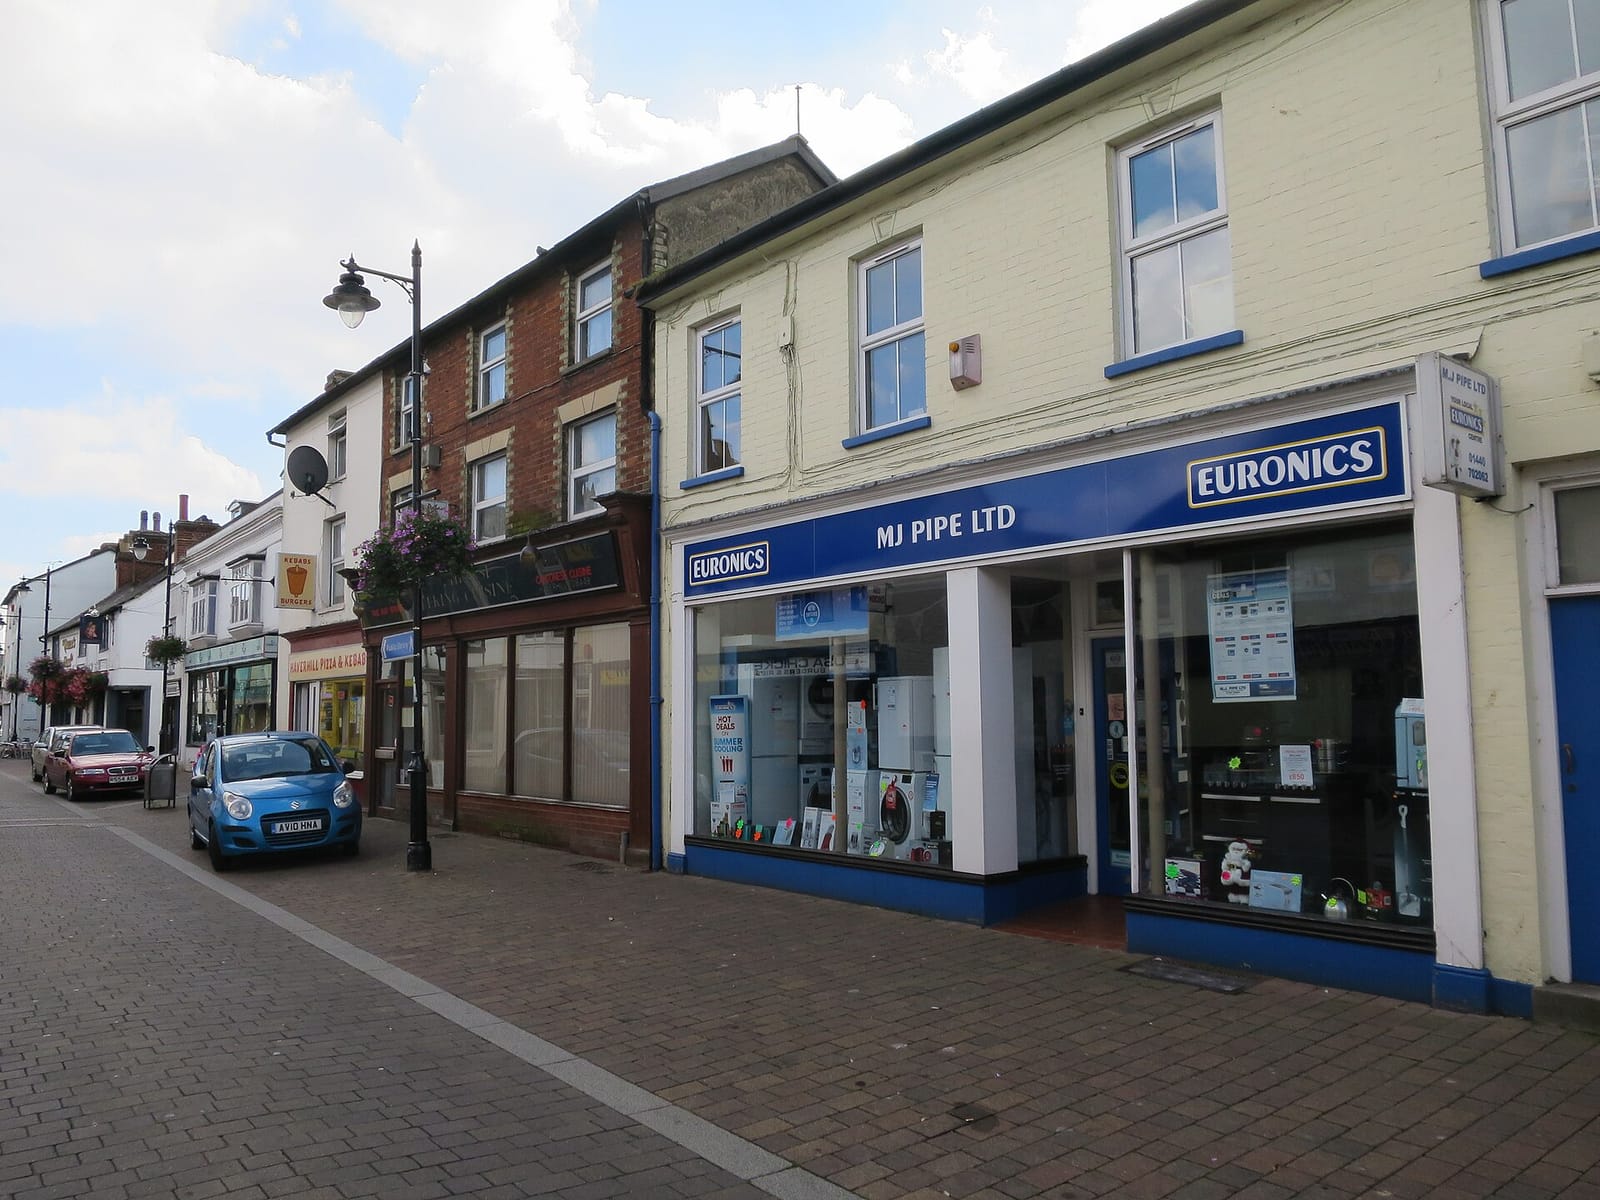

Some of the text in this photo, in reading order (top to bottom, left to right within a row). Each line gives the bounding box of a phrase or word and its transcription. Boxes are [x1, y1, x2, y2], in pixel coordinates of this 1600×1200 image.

[1456, 373, 1473, 390] PIPE
[1473, 380, 1487, 395] LTD
[1451, 407, 1483, 432] EURONICS
[1197, 439, 1375, 497] EURONICS
[876, 504, 1017, 550] MJ PIPE LTD
[284, 557, 312, 565] KEBABS
[692, 548, 766, 580] EURONICS
[280, 597, 313, 606] BURGERS
[289, 658, 319, 674] HAVERHILL
[319, 655, 337, 671] PIZZA
[337, 655, 344, 669] &
[716, 723, 735, 731] DEALS
[717, 716, 731, 724] HOT
[714, 745, 743, 753] COOLING
[279, 820, 318, 832] AV10 HNA
